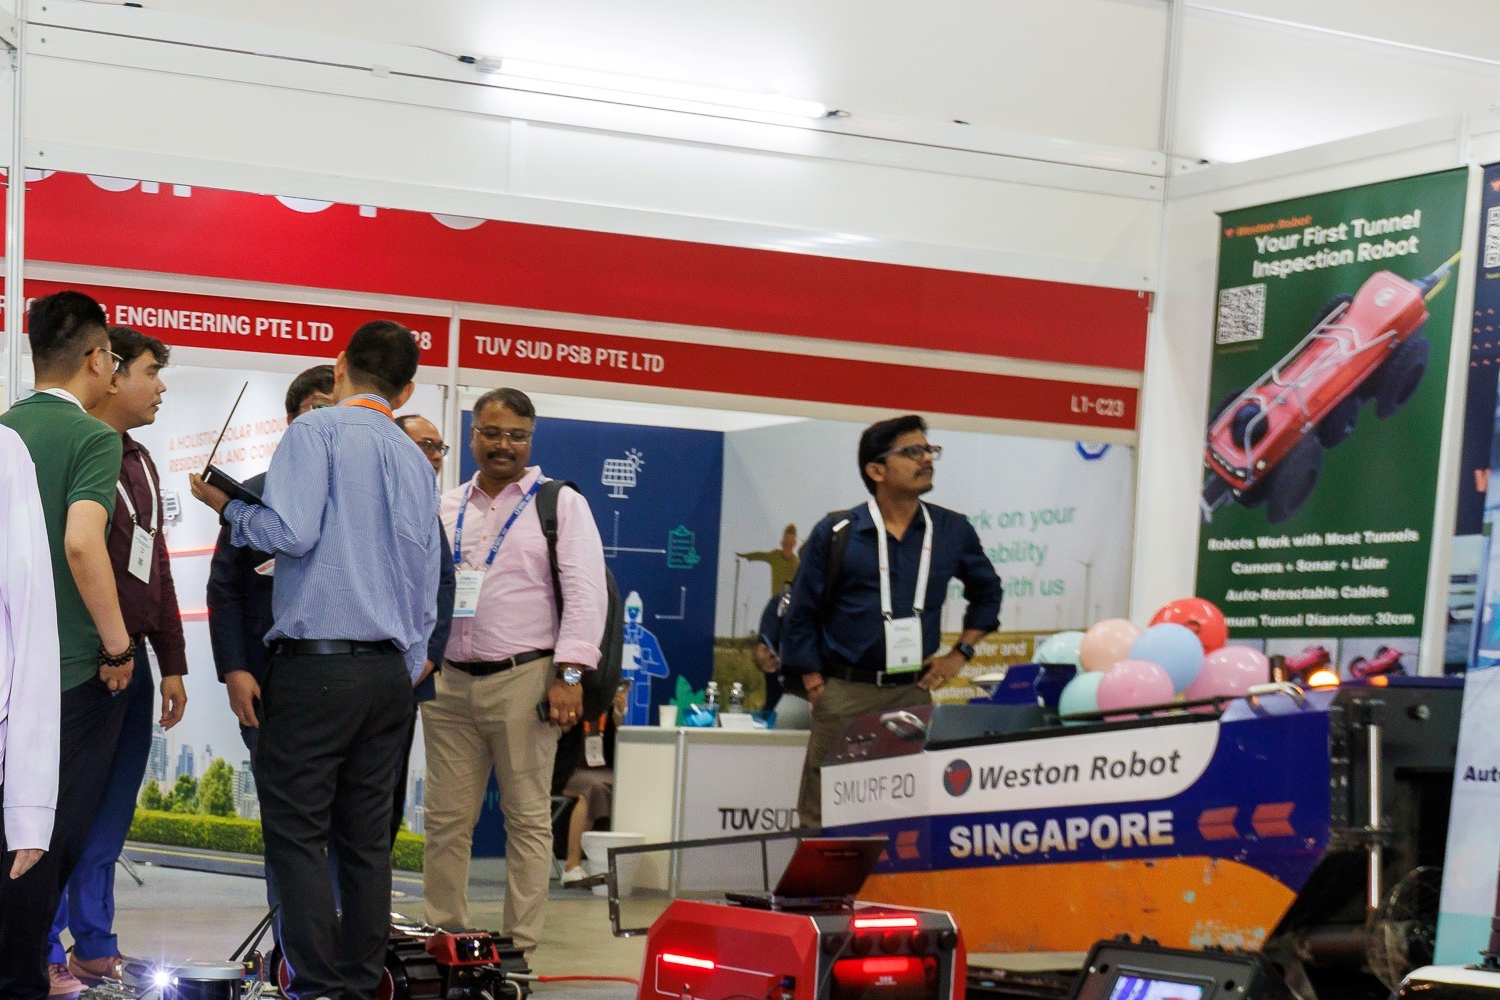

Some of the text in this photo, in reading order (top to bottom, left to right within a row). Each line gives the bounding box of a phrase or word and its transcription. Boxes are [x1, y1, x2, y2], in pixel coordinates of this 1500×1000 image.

[1255, 209, 1421, 254] Your First Tunnel
[1253, 235, 1419, 278] Inspection Robot
[115, 305, 250, 335] ENGINEERING
[255, 317, 292, 340] PTE
[296, 321, 334, 342] LTD
[474, 335, 512, 356] TUV
[515, 339, 552, 360] SUD
[556, 343, 591, 365] PSB
[596, 348, 628, 369] PTE
[631, 352, 665, 373] LTD
[998, 512, 1025, 528] on
[1030, 506, 1076, 532] your
[1208, 528, 1419, 551] Robots Work with Most Tunnels
[1231, 561, 1284, 575] Camera
[1296, 559, 1337, 572] Sonar
[1352, 556, 1388, 570] Lidar
[1040, 578, 1066, 596] us
[1340, 584, 1388, 599] Cables
[1260, 613, 1304, 627] Tunnel
[1375, 612, 1415, 625] 30cm
[979, 750, 1181, 790] Weston Robot
[1463, 765, 1500, 783] Aut
[832, 772, 916, 806] SMURF 20
[949, 810, 1174, 859] SINGAPORE
